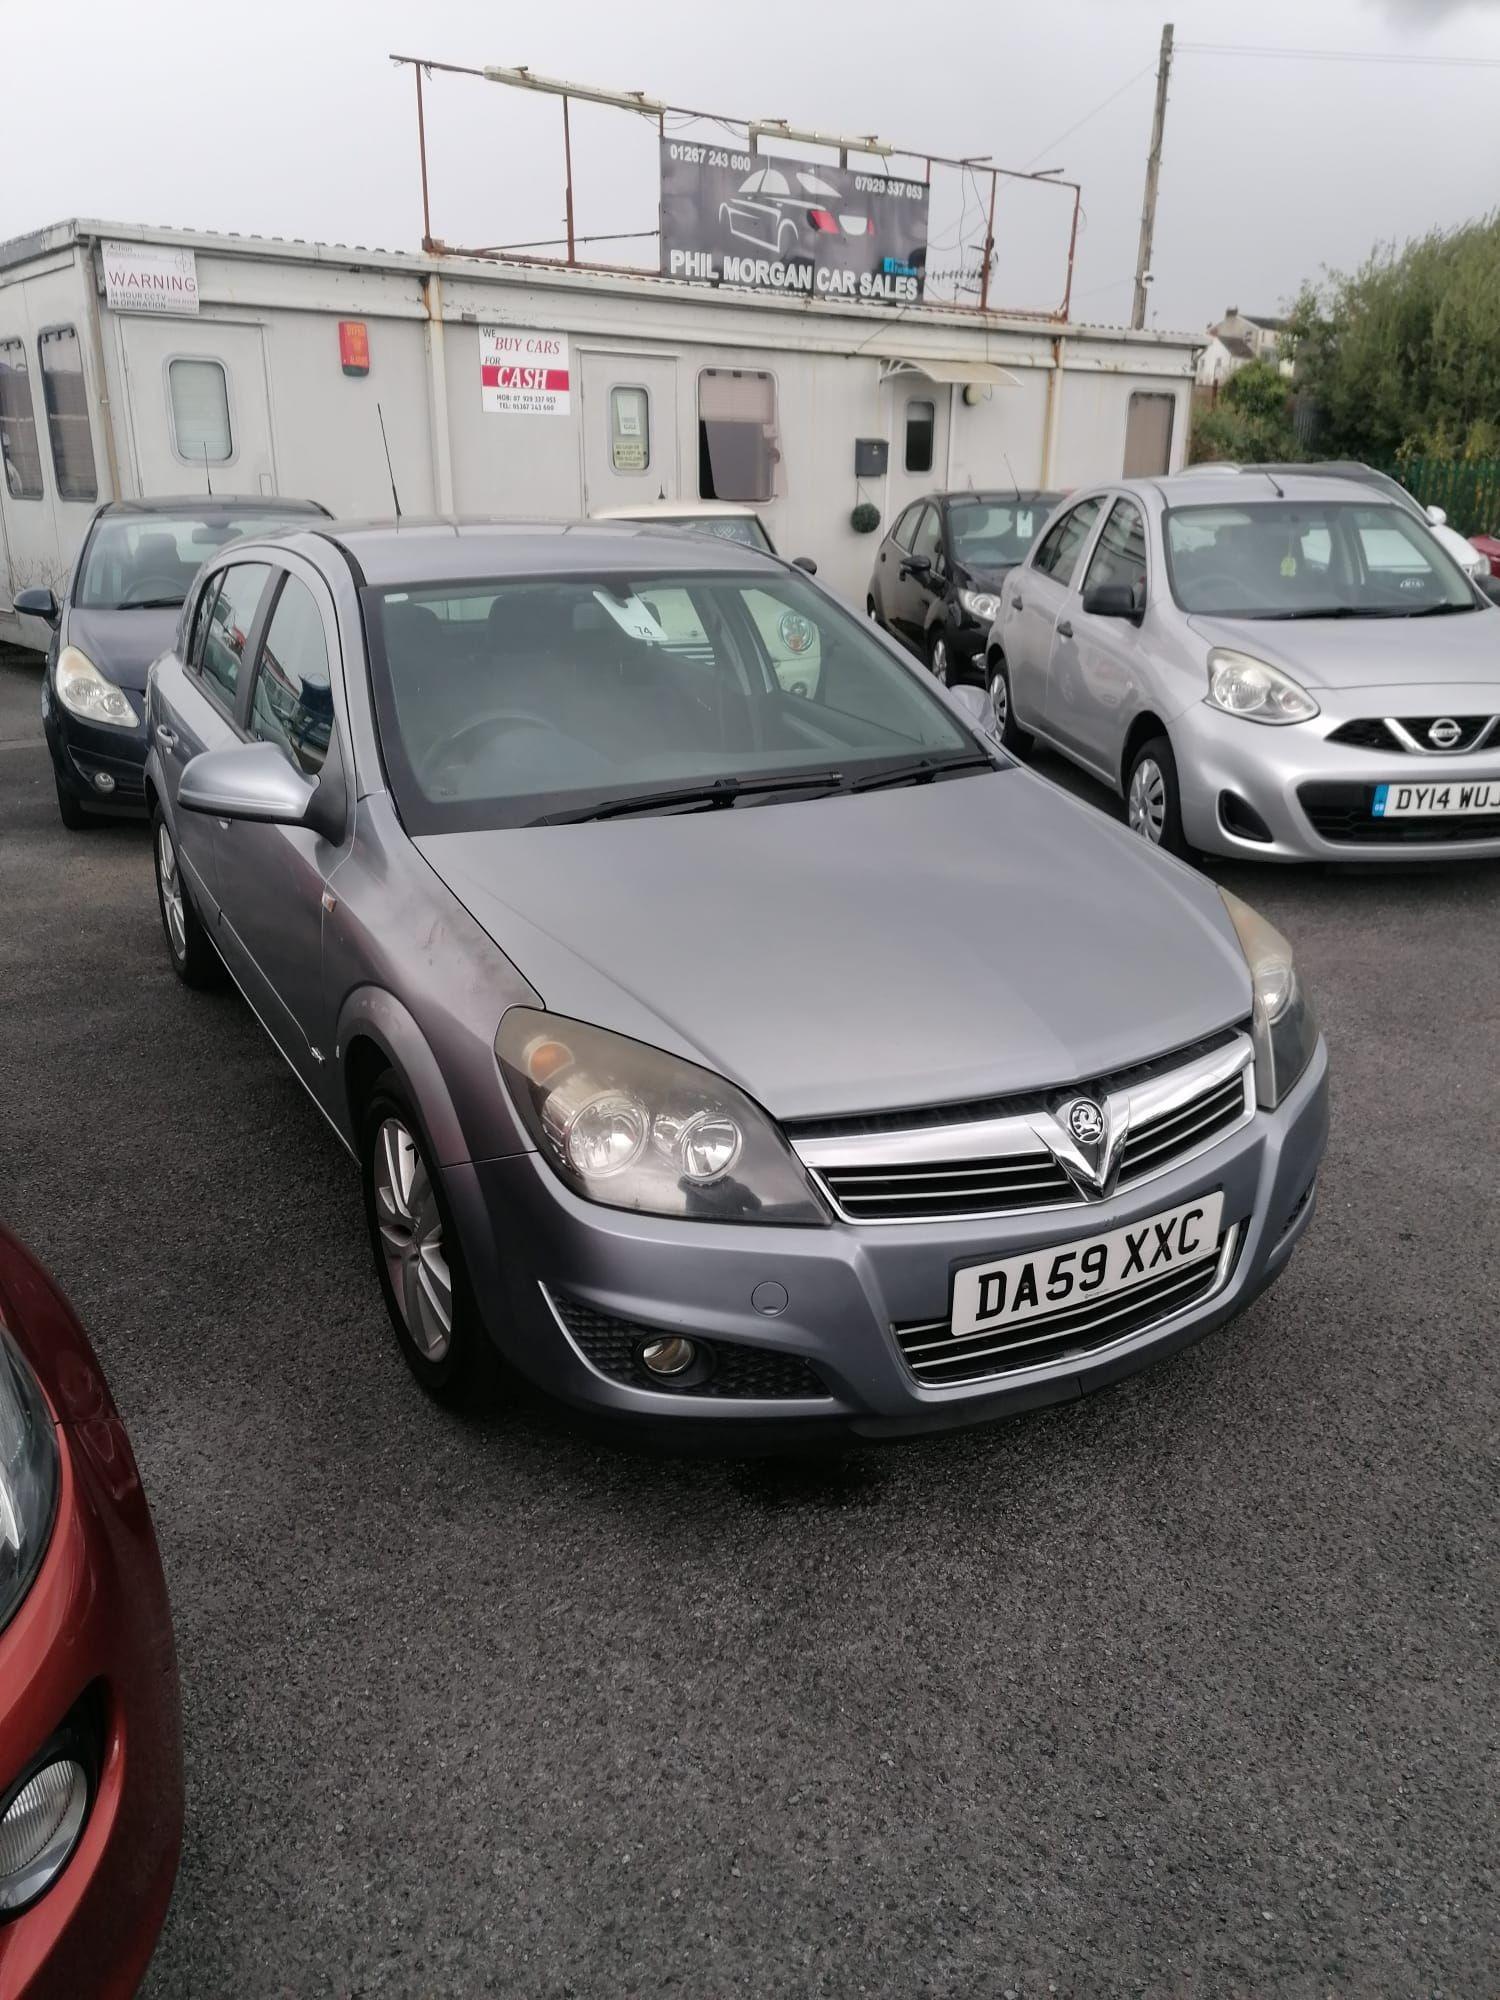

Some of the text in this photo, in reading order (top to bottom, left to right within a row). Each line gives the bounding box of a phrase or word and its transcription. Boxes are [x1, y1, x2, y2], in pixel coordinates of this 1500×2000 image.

[669, 143, 751, 171] 01267 243 600
[855, 175, 885, 195] 07929
[887, 180, 905, 197] 337
[108, 271, 196, 292] WARNING
[670, 250, 918, 301] PHIL MORGAN CAR SALES
[120, 290, 142, 300] HOUR
[144, 292, 167, 302] CCTV
[120, 300, 166, 309] OPERATION
[482, 327, 496, 338] WE
[495, 336, 561, 355] BUY CARS
[485, 356, 501, 366] FOR
[497, 367, 548, 389] CASH
[1395, 788, 1451, 810] DY14
[975, 1208, 1204, 1322] DA59 XXC
